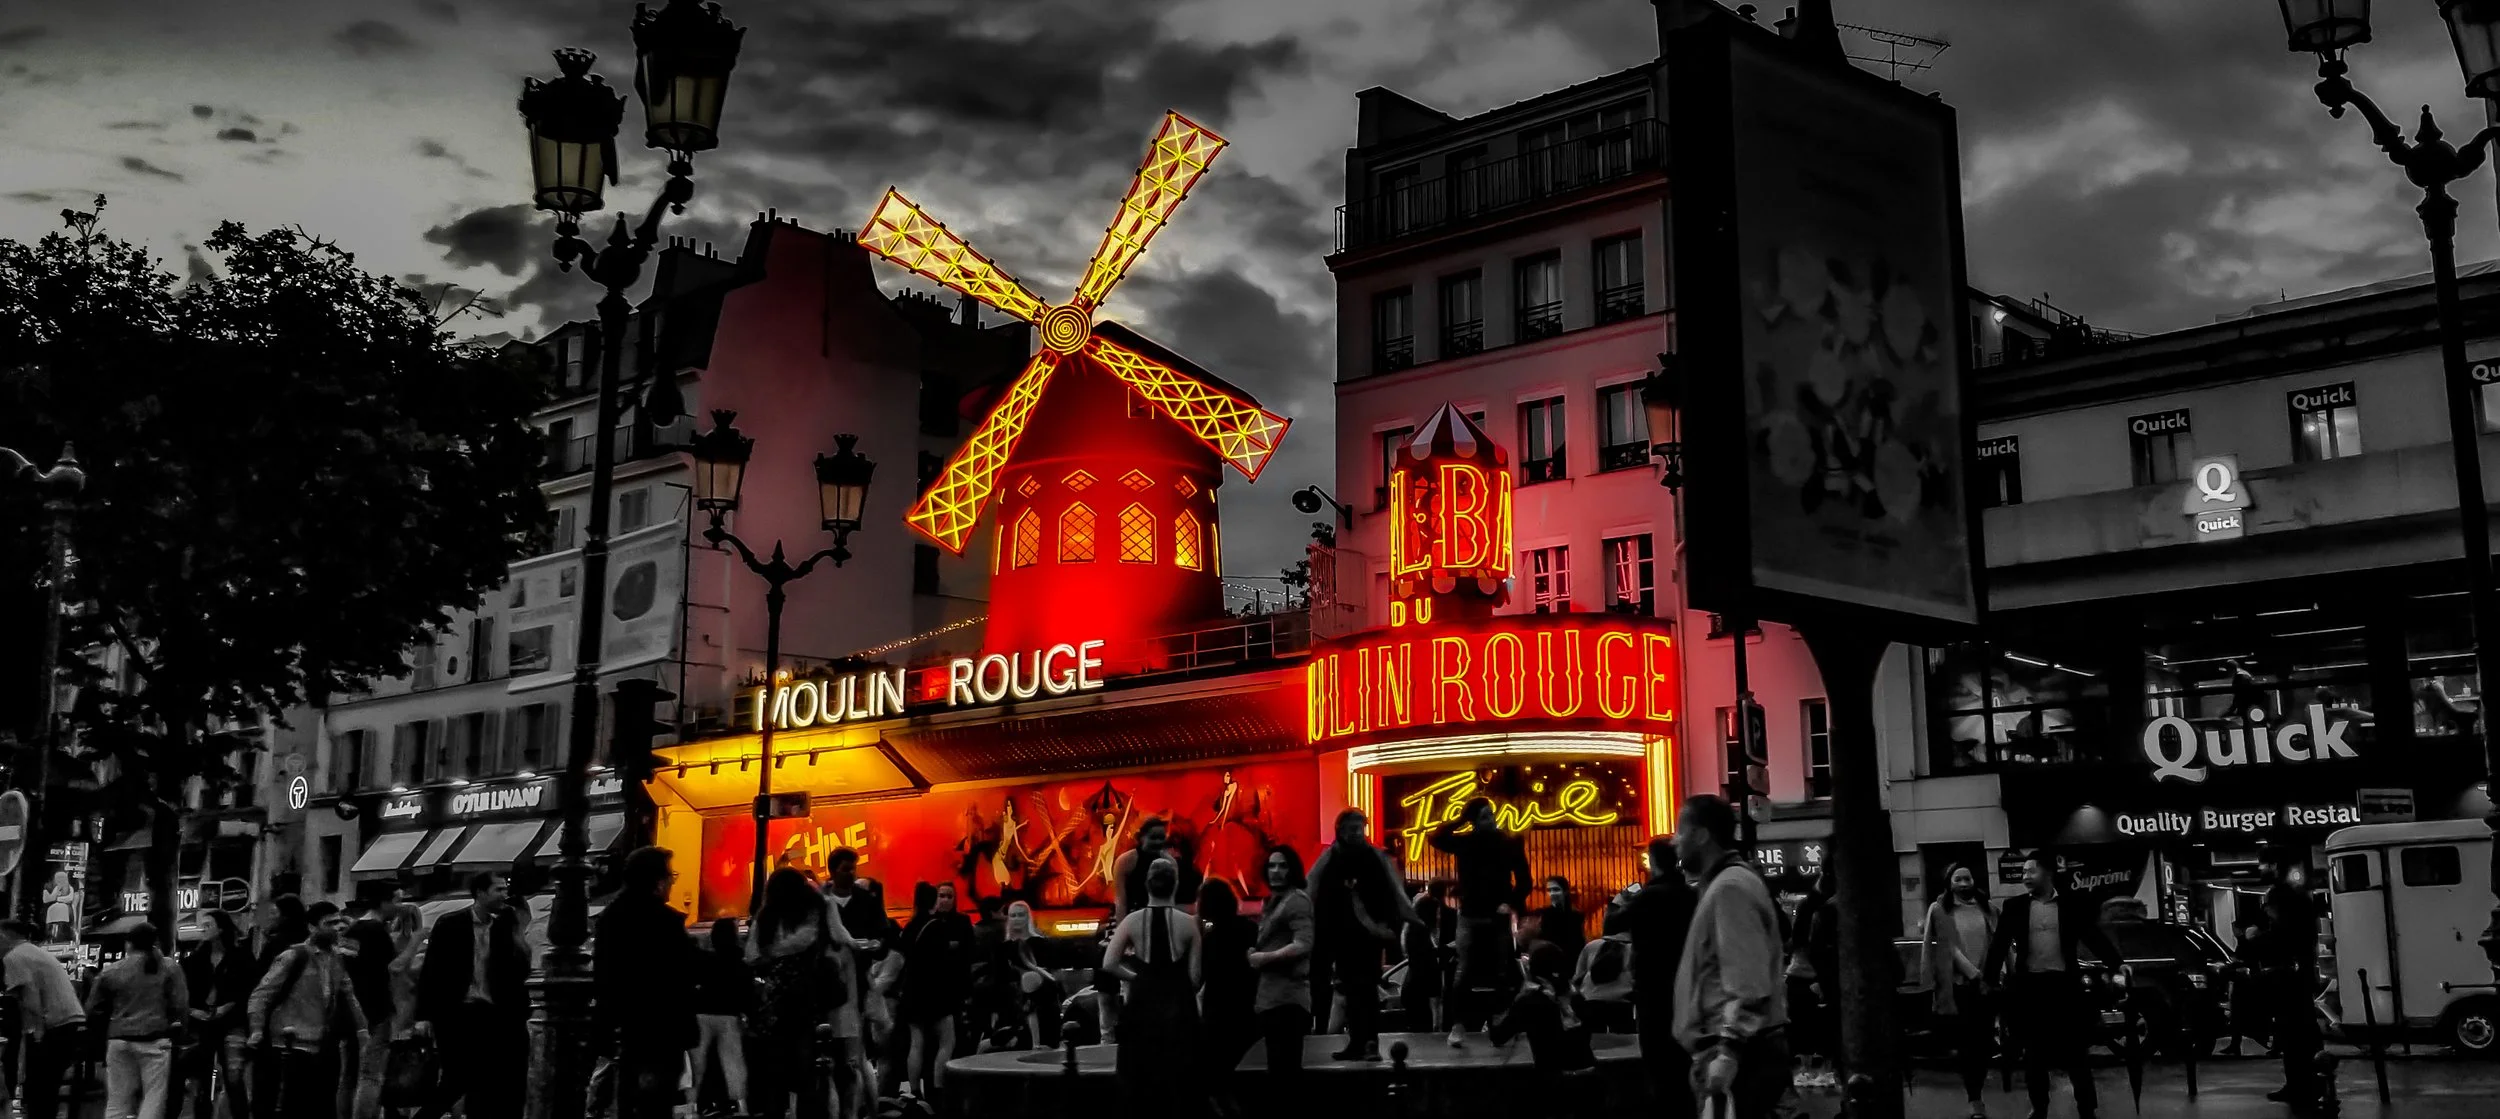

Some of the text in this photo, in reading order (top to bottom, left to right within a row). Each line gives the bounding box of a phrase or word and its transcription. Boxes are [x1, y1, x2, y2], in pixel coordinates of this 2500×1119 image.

[2290, 386, 2353, 412] Quick
[2132, 413, 2188, 436] Quick
[2196, 462, 2237, 503] Q
[2197, 515, 2240, 533] Quick
[1391, 597, 1431, 628] DU
[753, 639, 1105, 732] MOULIN ROUGE
[1432, 630, 1673, 724] ROUGE
[2143, 703, 2360, 782] Quick
[2117, 812, 2192, 836] Quality
[2203, 809, 2276, 832] Burger
[124, 893, 149, 912] THE
